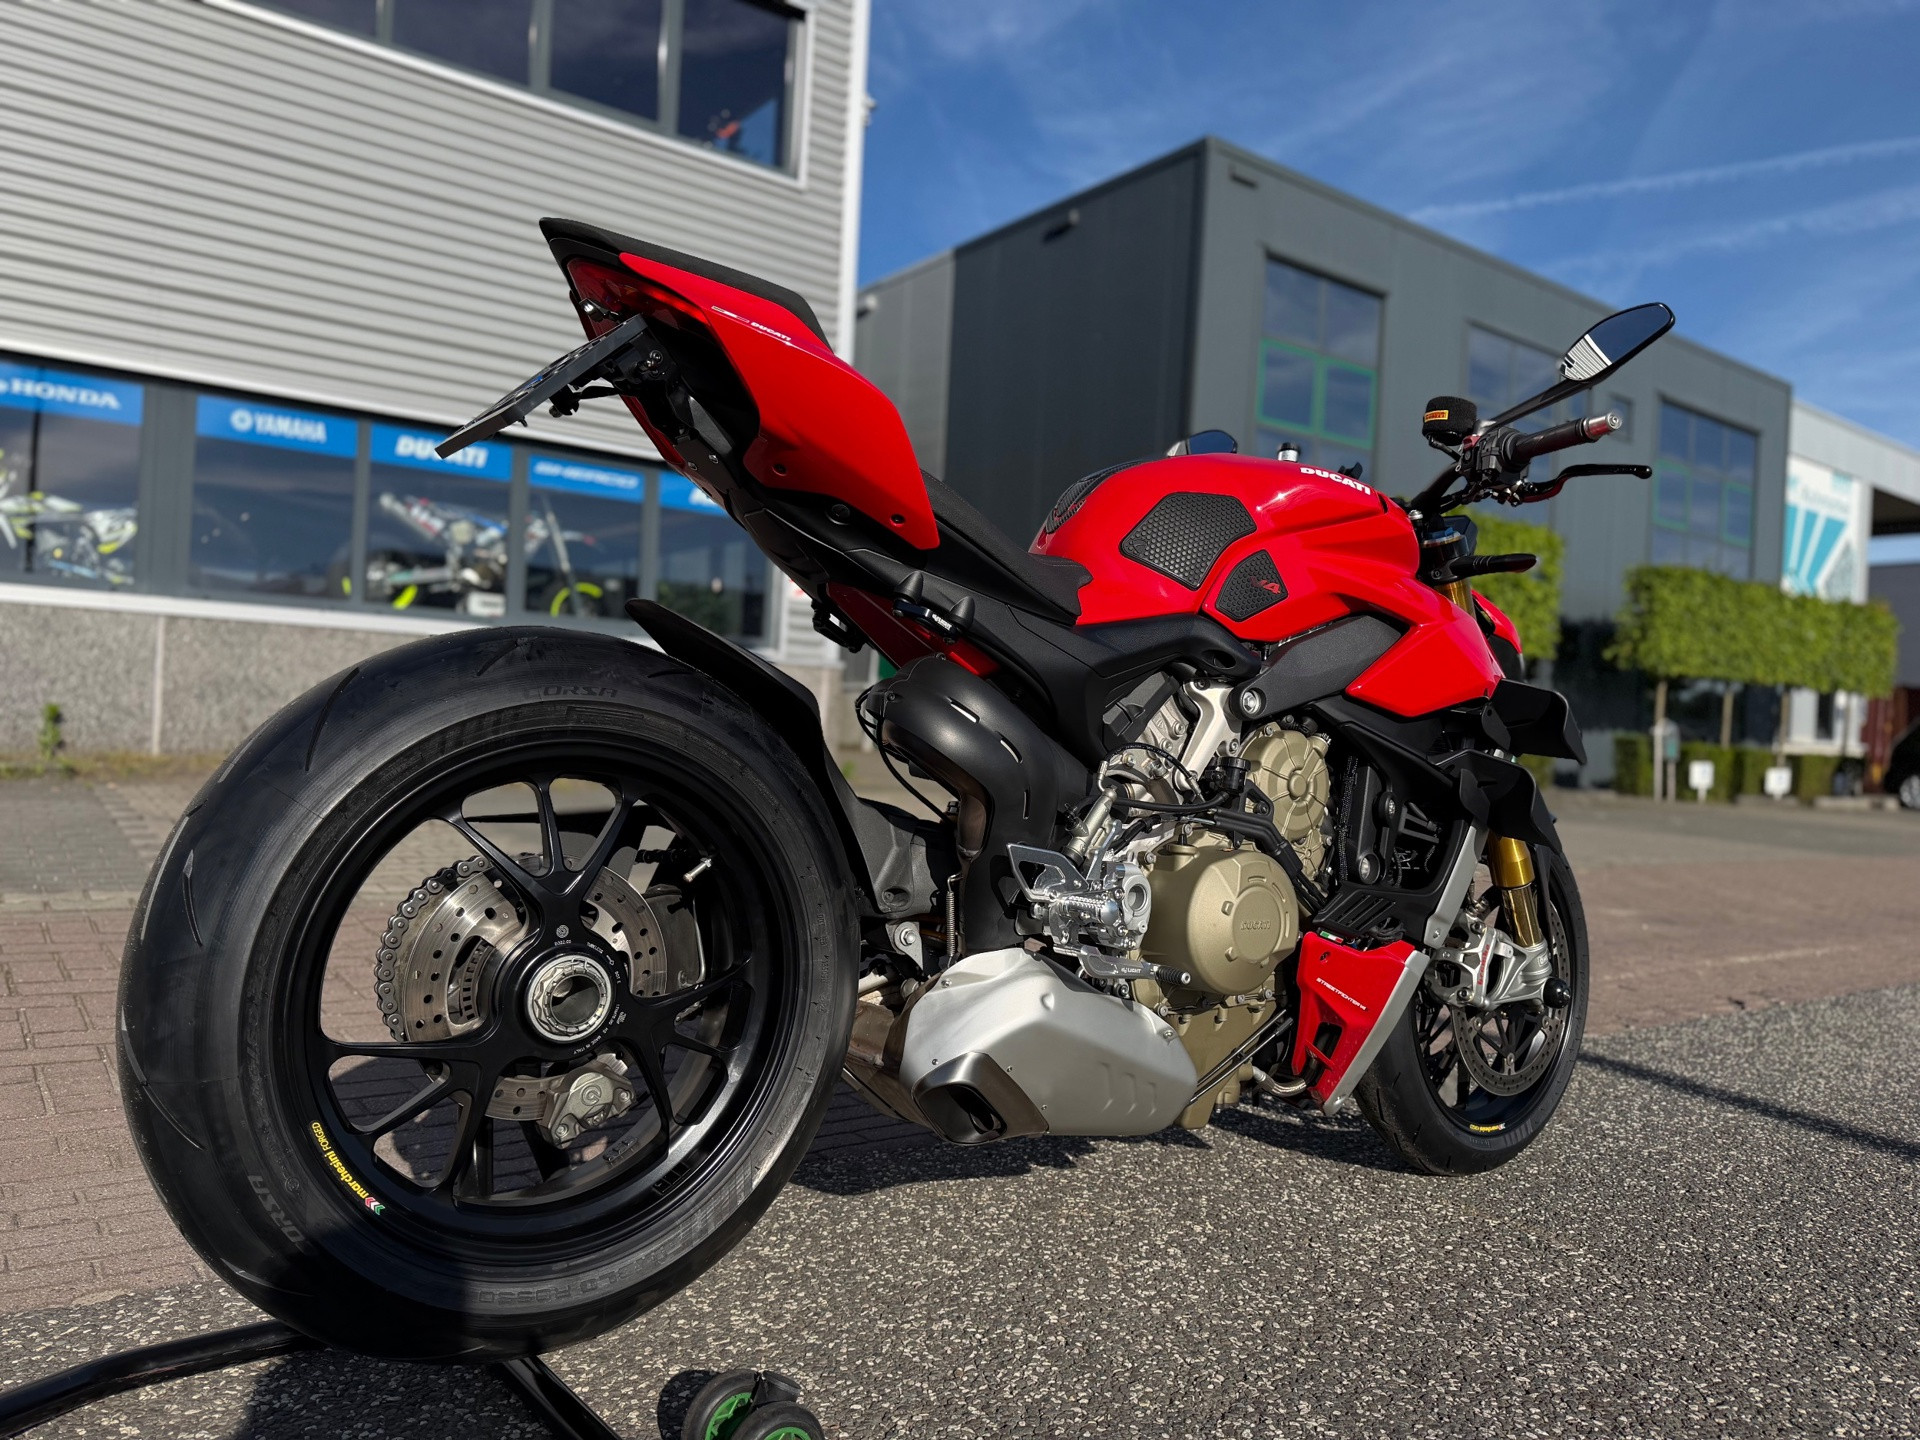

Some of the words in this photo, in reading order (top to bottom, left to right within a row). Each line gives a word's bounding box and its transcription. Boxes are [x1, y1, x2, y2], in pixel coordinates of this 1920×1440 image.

[751, 321, 792, 341] DUCATI
[10, 377, 121, 410] HONDA
[254, 411, 327, 443] YAMAHA
[394, 434, 489, 469] DUATI
[1299, 466, 1371, 495] DUCATI
[1240, 919, 1271, 930] DUCATI
[1315, 976, 1360, 1007] STREETFIGHTER
[311, 1122, 332, 1151] FORGED
[324, 1150, 369, 1199] marchesini
